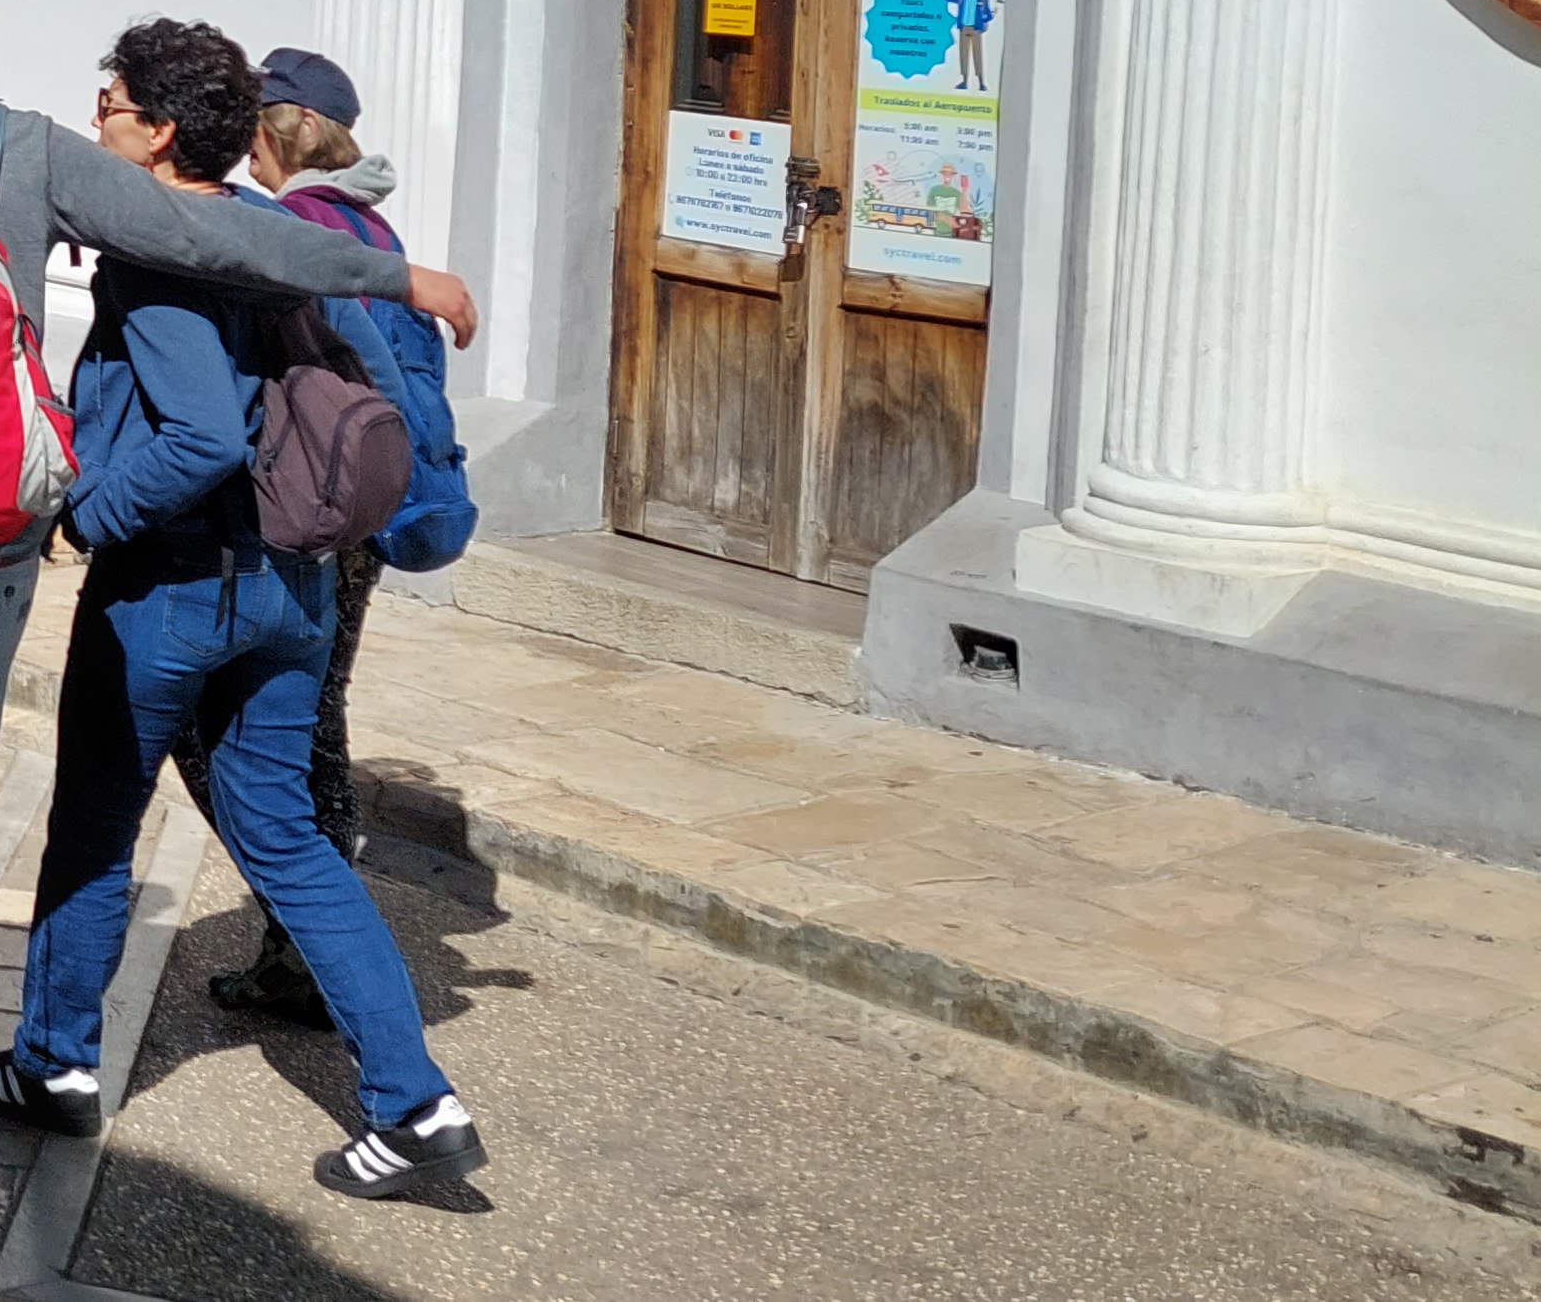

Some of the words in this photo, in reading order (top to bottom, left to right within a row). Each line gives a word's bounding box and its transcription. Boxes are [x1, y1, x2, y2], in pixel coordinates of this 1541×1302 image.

[874, 96, 920, 108] Traslados
[934, 101, 992, 114] Aeropuerto
[708, 128, 725, 138] VISA
[884, 248, 961, 264] syctravel.com
